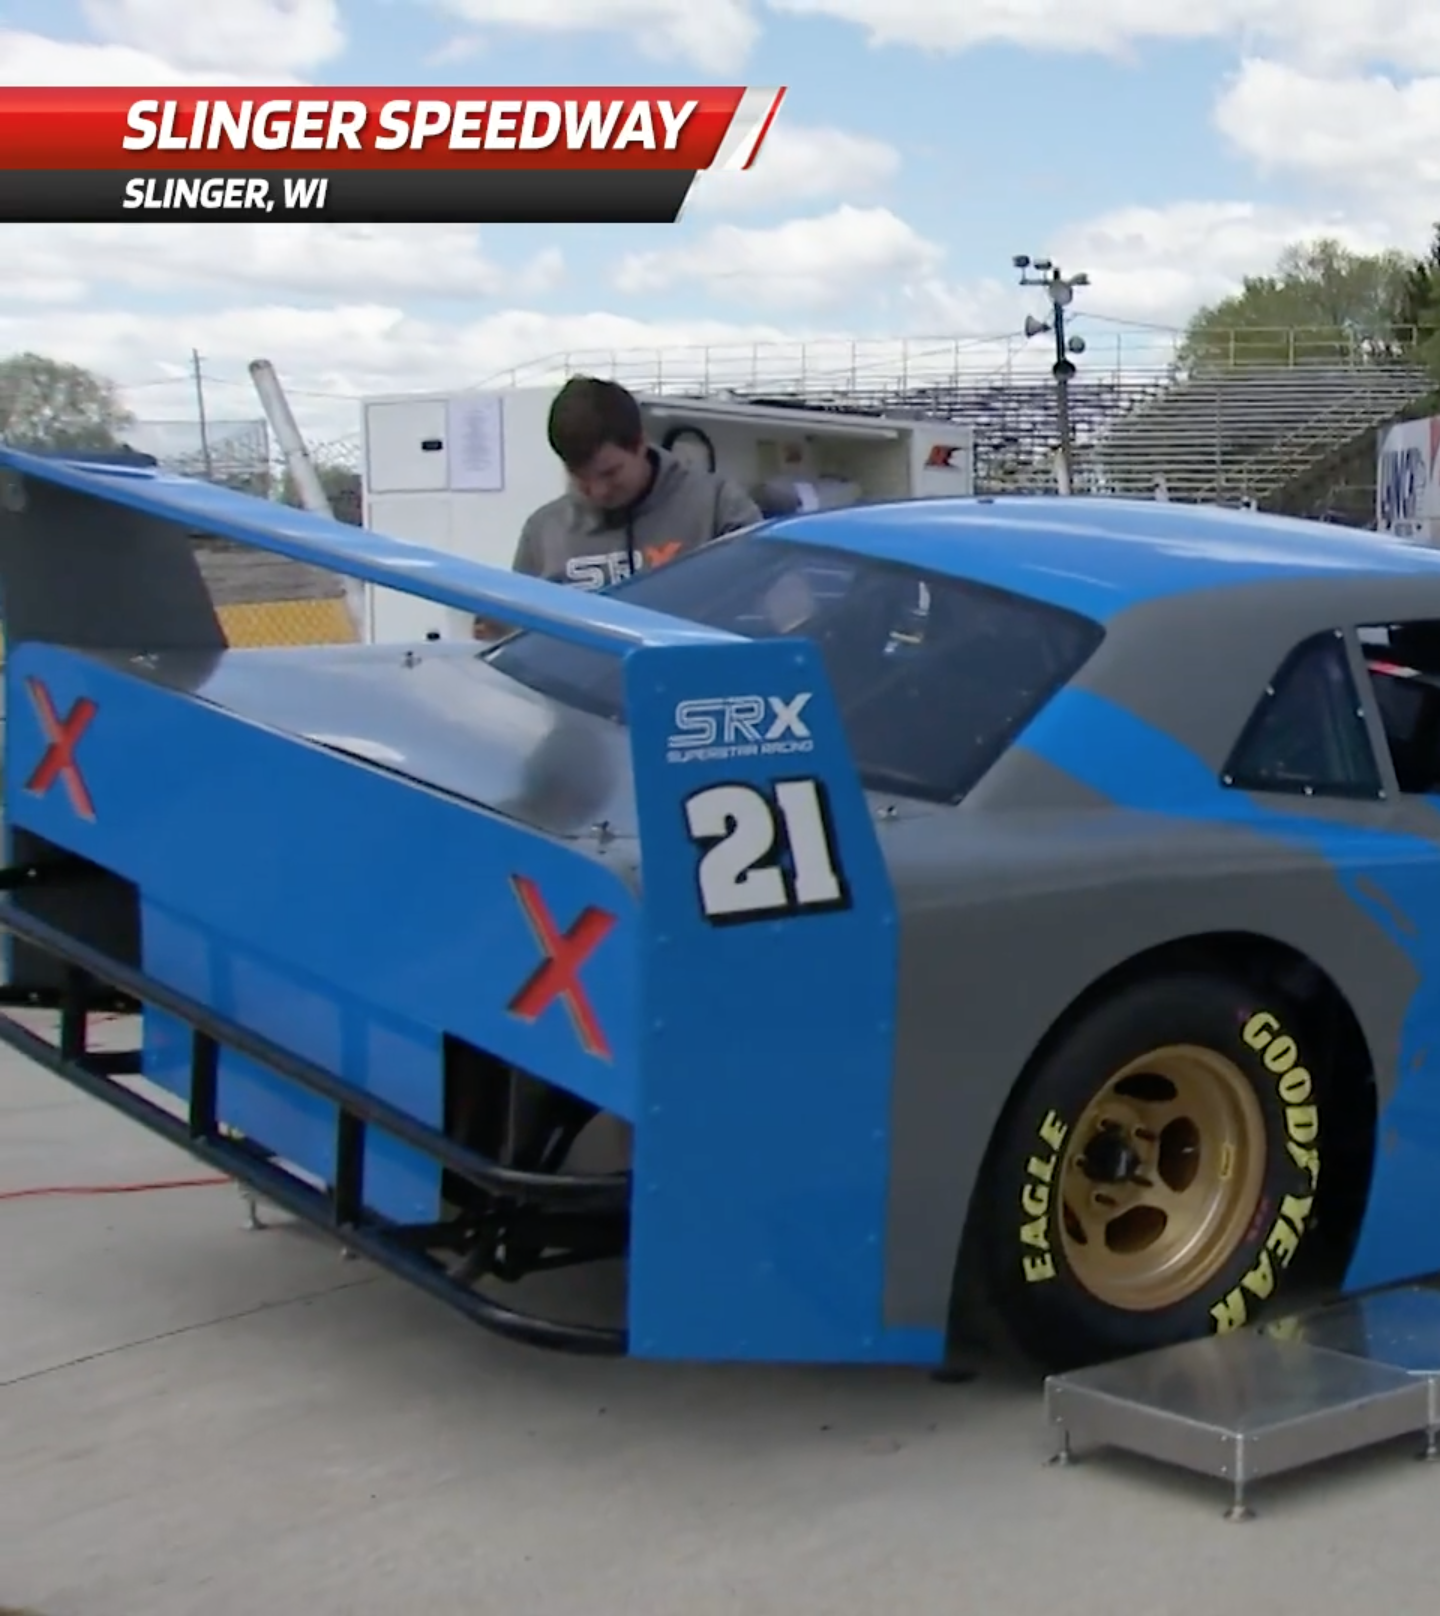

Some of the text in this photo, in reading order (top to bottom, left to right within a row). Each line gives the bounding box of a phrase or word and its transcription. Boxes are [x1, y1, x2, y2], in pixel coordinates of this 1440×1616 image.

[667, 692, 813, 747] SRX
[684, 774, 850, 926] 21
[1020, 1109, 1069, 1282] EAGLE
